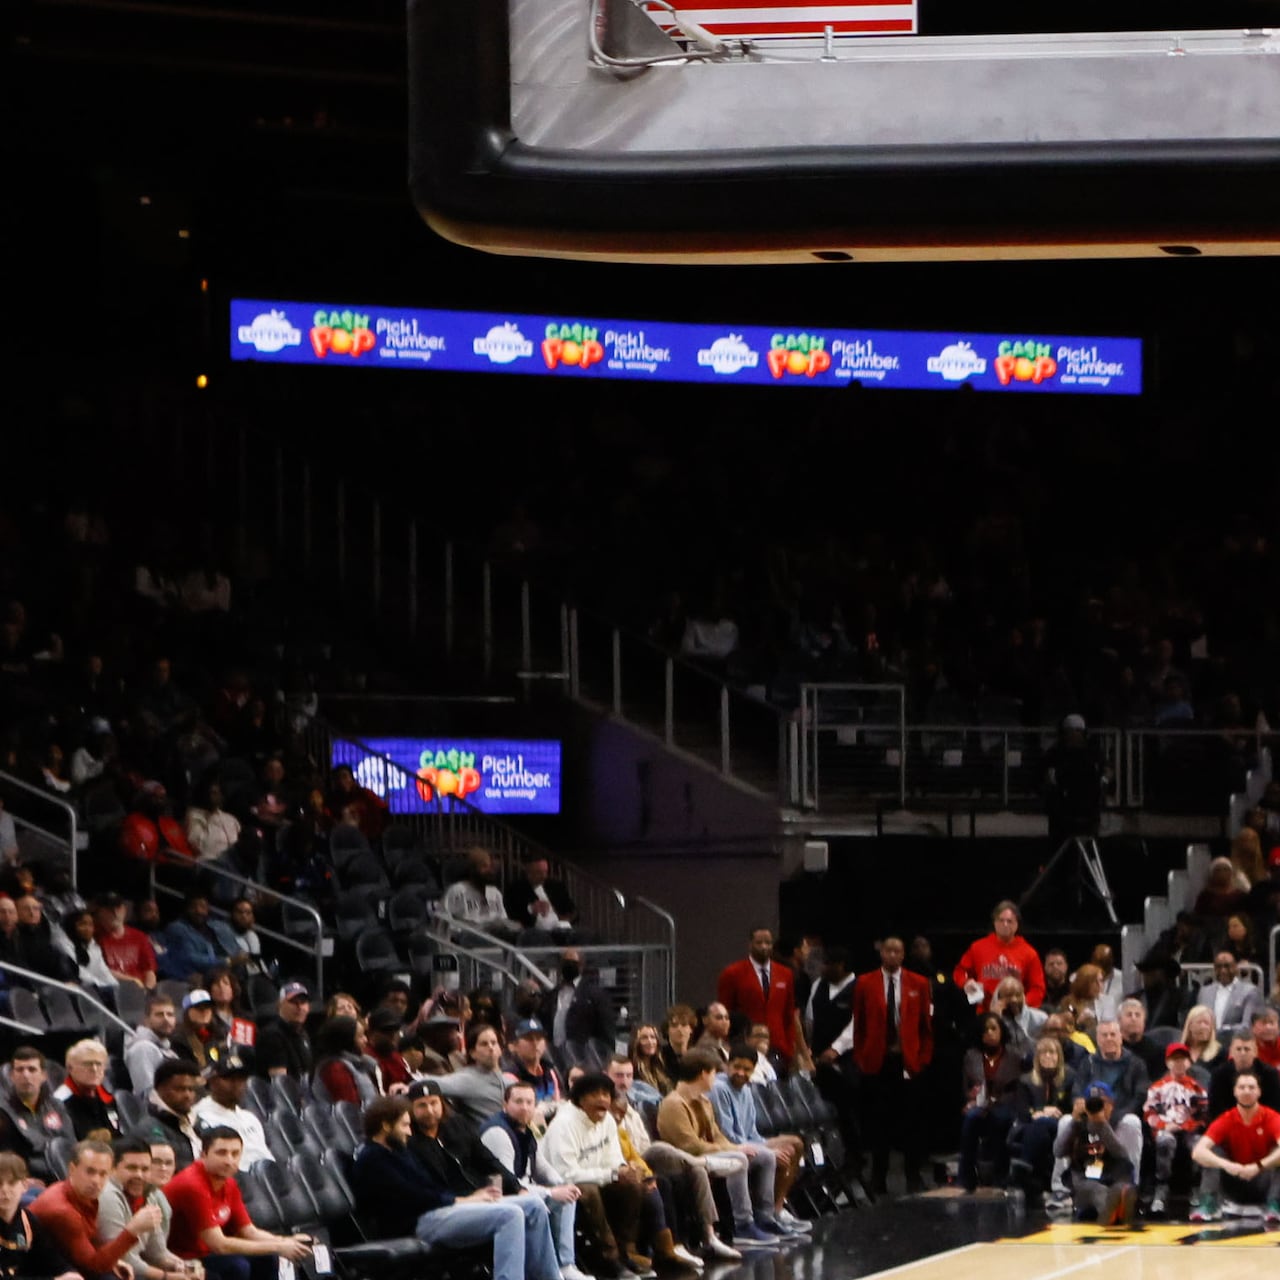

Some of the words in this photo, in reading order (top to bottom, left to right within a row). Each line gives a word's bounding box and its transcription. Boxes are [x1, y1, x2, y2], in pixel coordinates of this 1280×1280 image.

[309, 326, 376, 358] POP
[541, 338, 604, 369] POP
[767, 350, 832, 379] POP
[995, 356, 1057, 385] POP
[416, 767, 481, 802] POP
